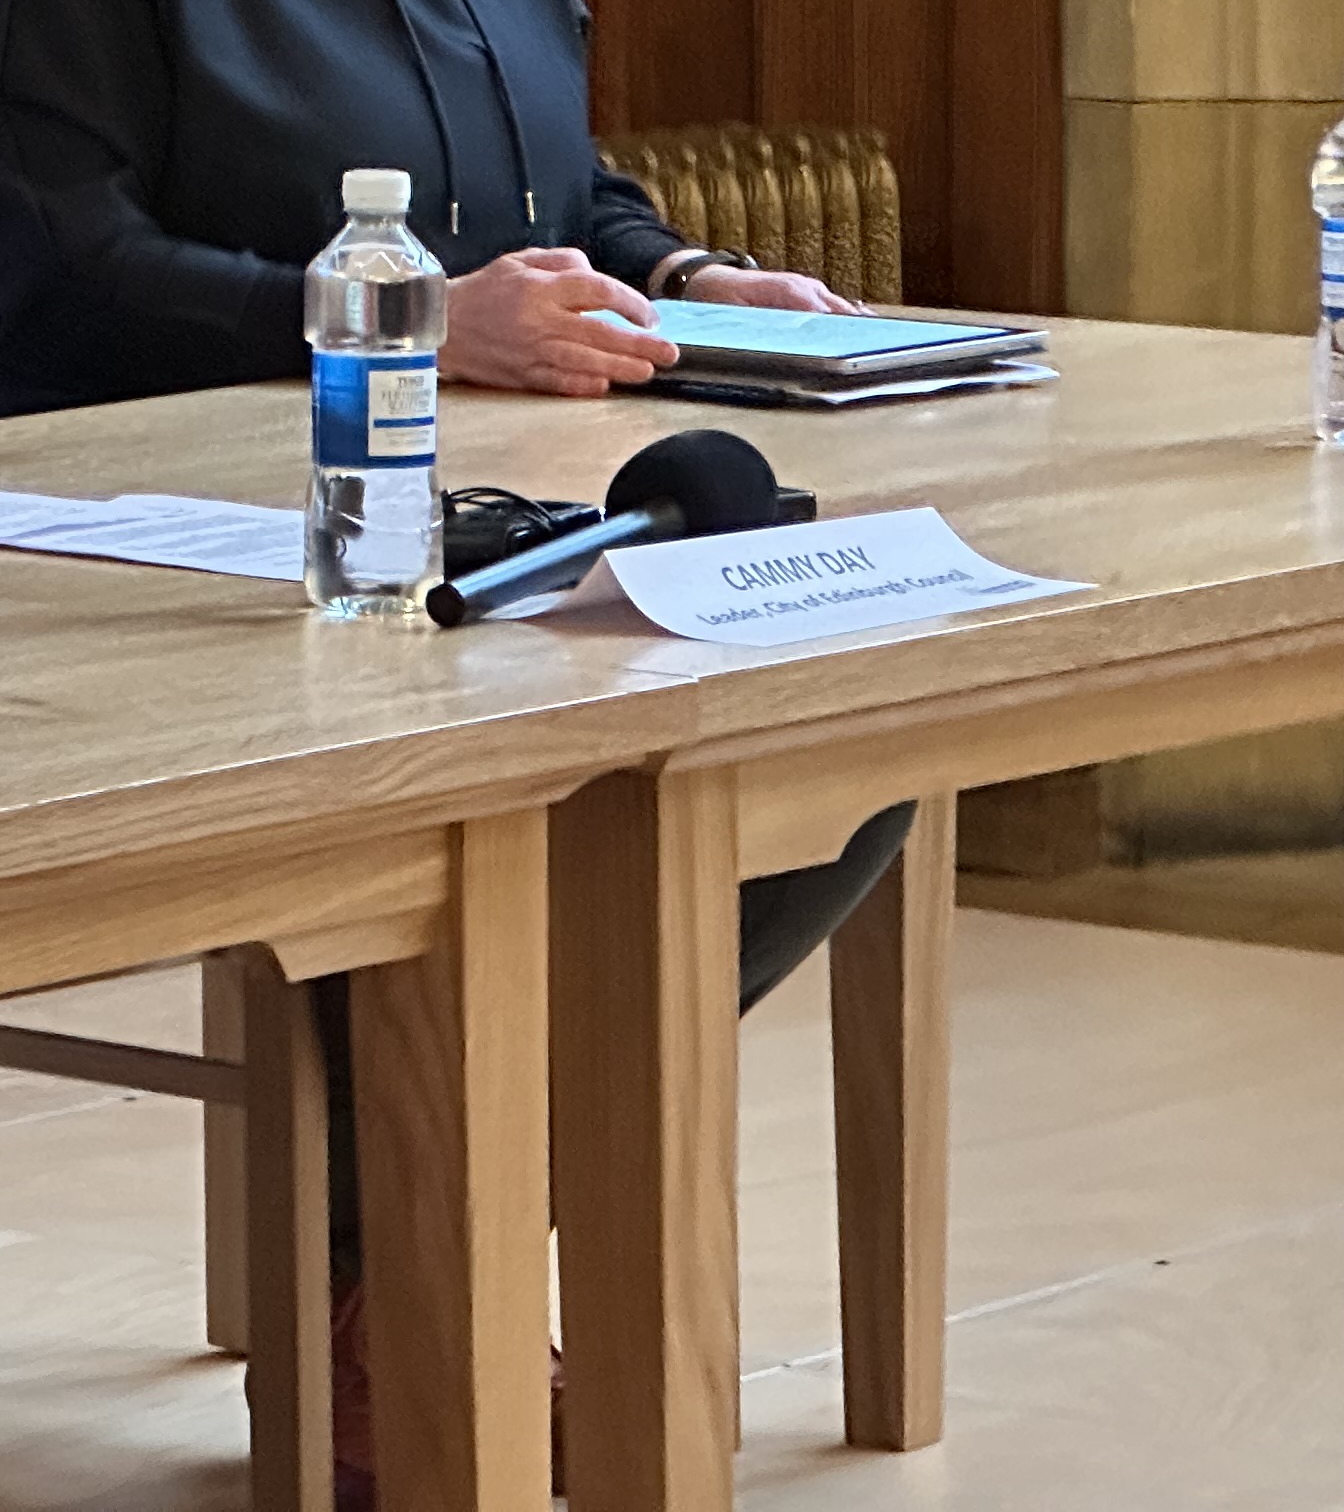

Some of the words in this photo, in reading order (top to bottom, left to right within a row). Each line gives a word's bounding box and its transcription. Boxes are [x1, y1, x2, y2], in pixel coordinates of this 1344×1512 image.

[720, 554, 824, 591] CAMMY
[816, 546, 876, 576] DAY
[818, 580, 908, 605] Edinburgh
